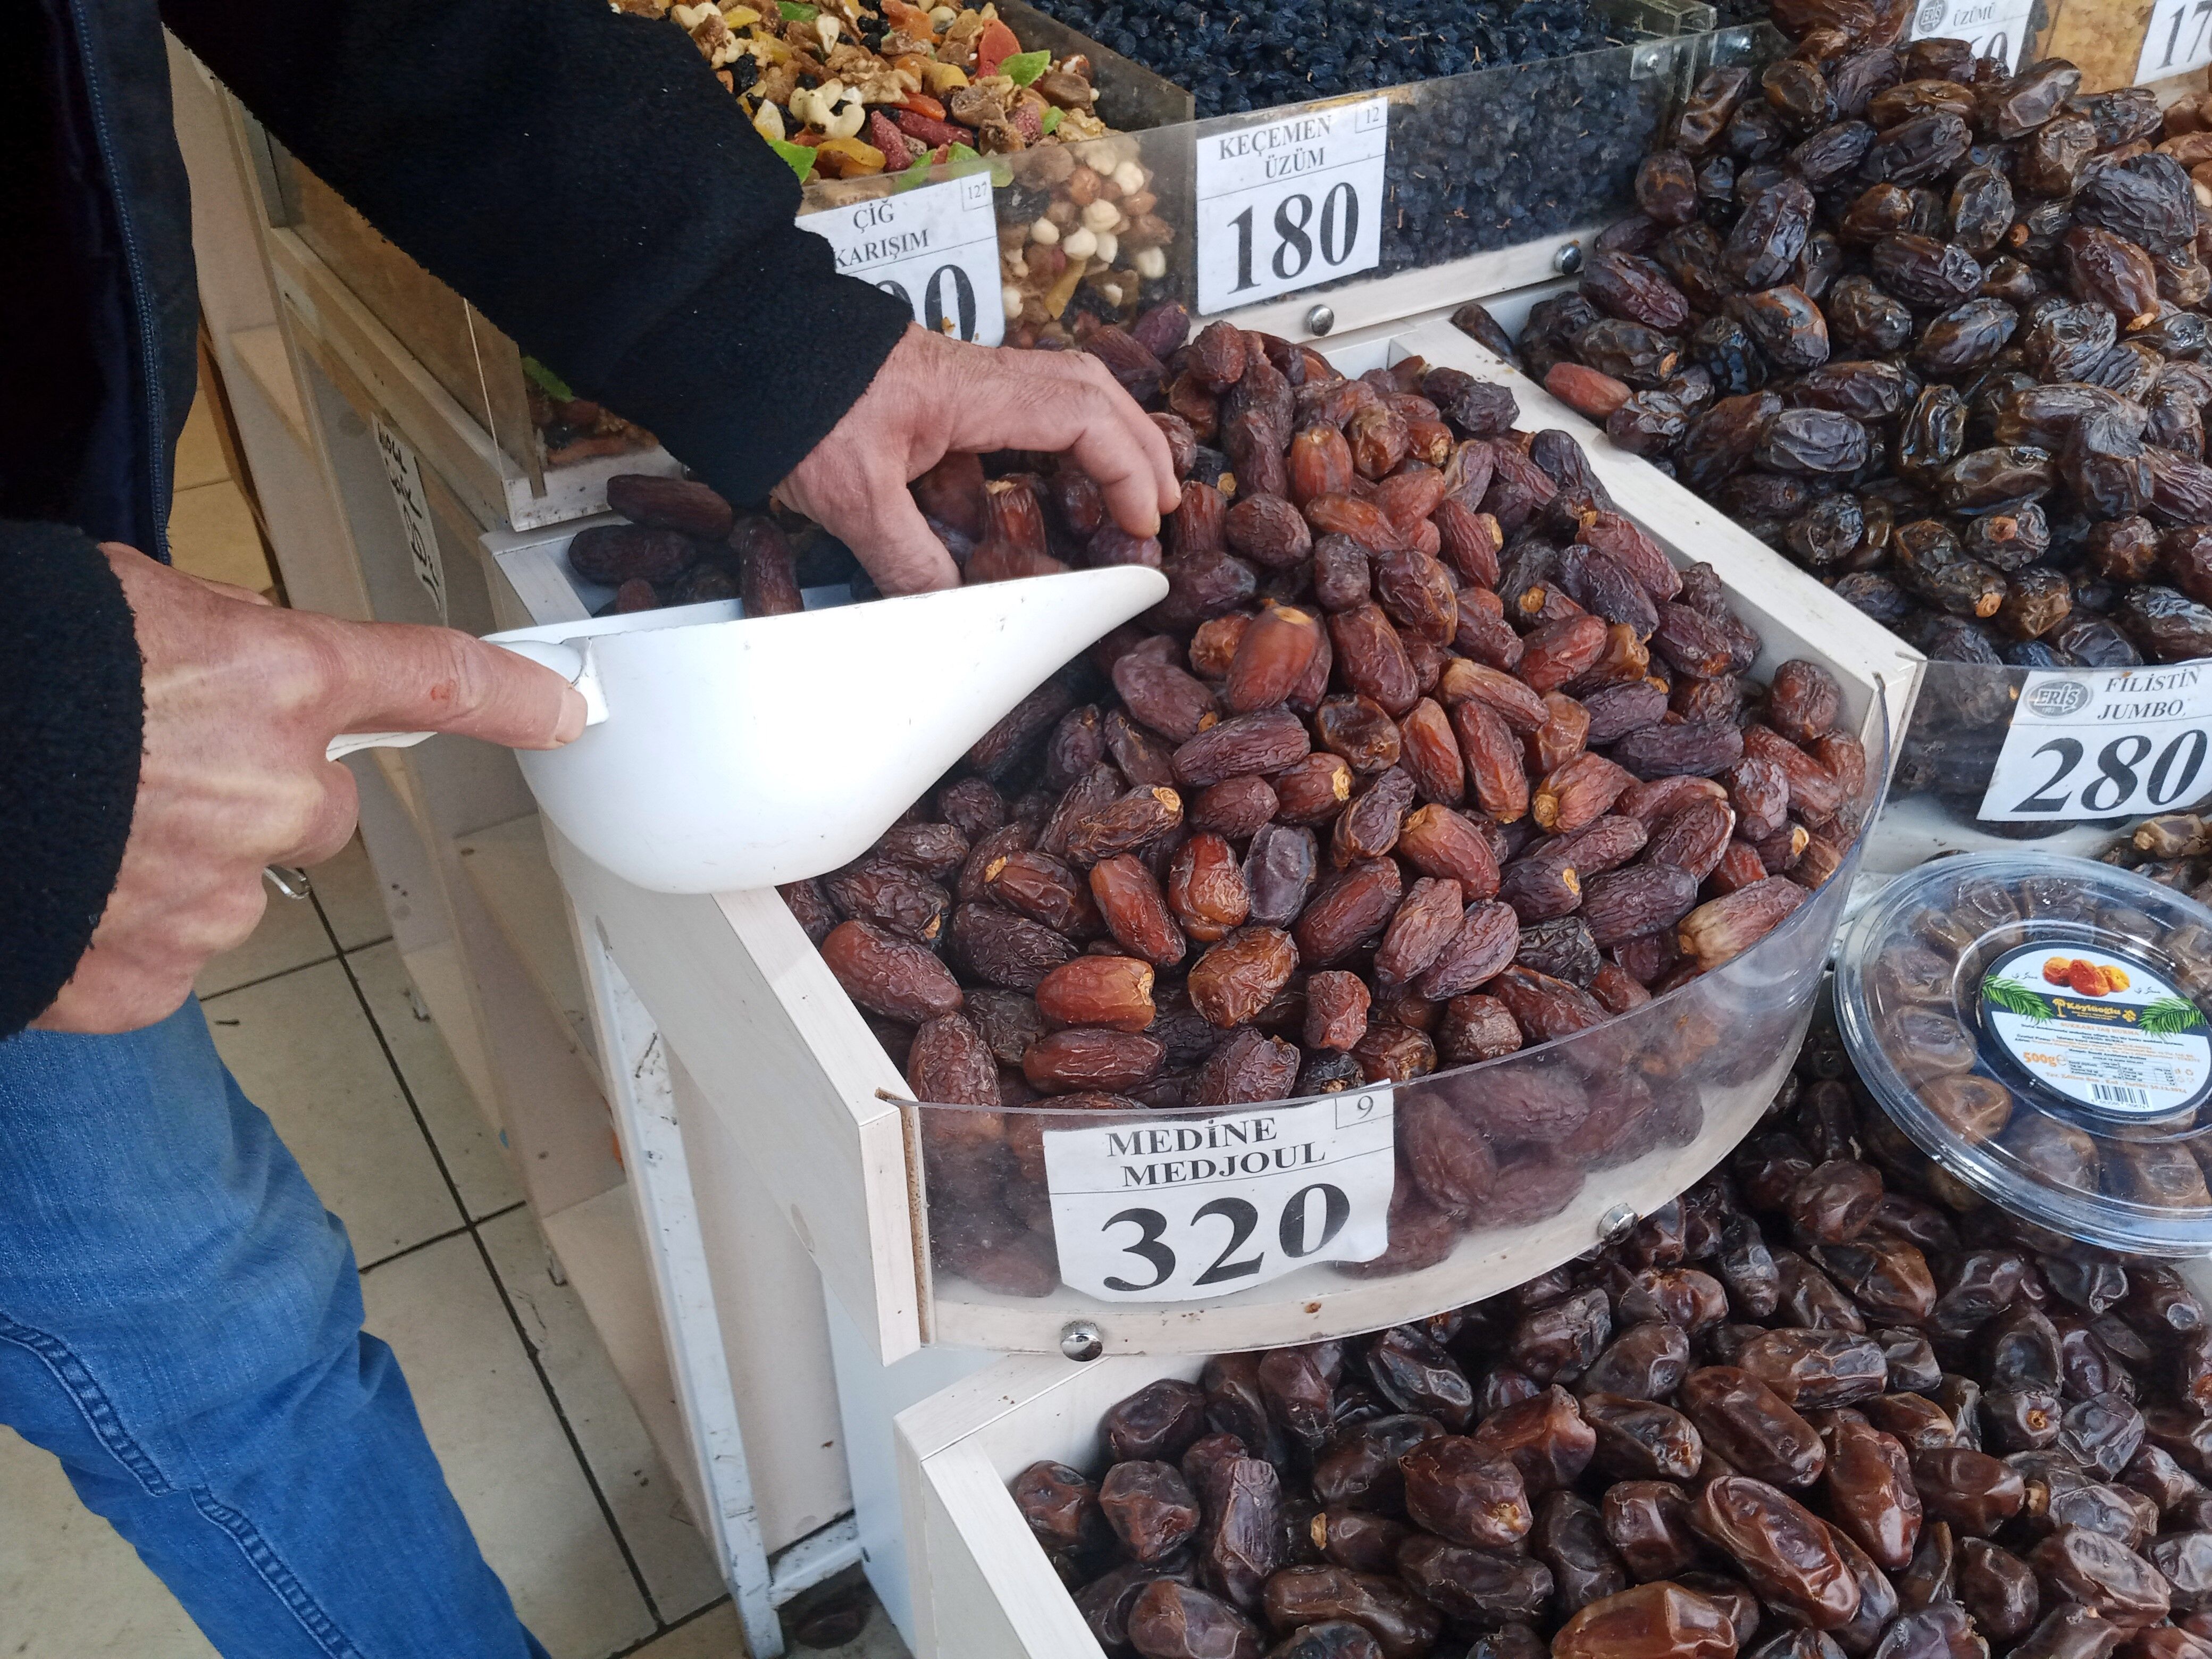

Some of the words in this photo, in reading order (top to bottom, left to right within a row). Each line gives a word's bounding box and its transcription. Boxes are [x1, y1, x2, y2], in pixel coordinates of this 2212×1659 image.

[2156, 1, 2212, 70] 17
[1365, 107, 1379, 124] 12
[1219, 115, 1332, 161] KEÇEMEN
[1265, 147, 1326, 179] ÜZÜM
[967, 181, 988, 200] 127
[853, 198, 894, 233] ÇİĞ
[834, 229, 929, 269] KARIŞIM
[1227, 182, 1359, 295] 180
[2097, 699, 2184, 720] JUMBO
[2010, 729, 2208, 812] 280
[2023, 1051, 2057, 1068] 500g
[1356, 1095, 1373, 1119] 9
[1105, 1118, 1278, 1157] MEDİNE
[1122, 1142, 1326, 1187] MEDJOUL
[1102, 1184, 1350, 1292] 320
